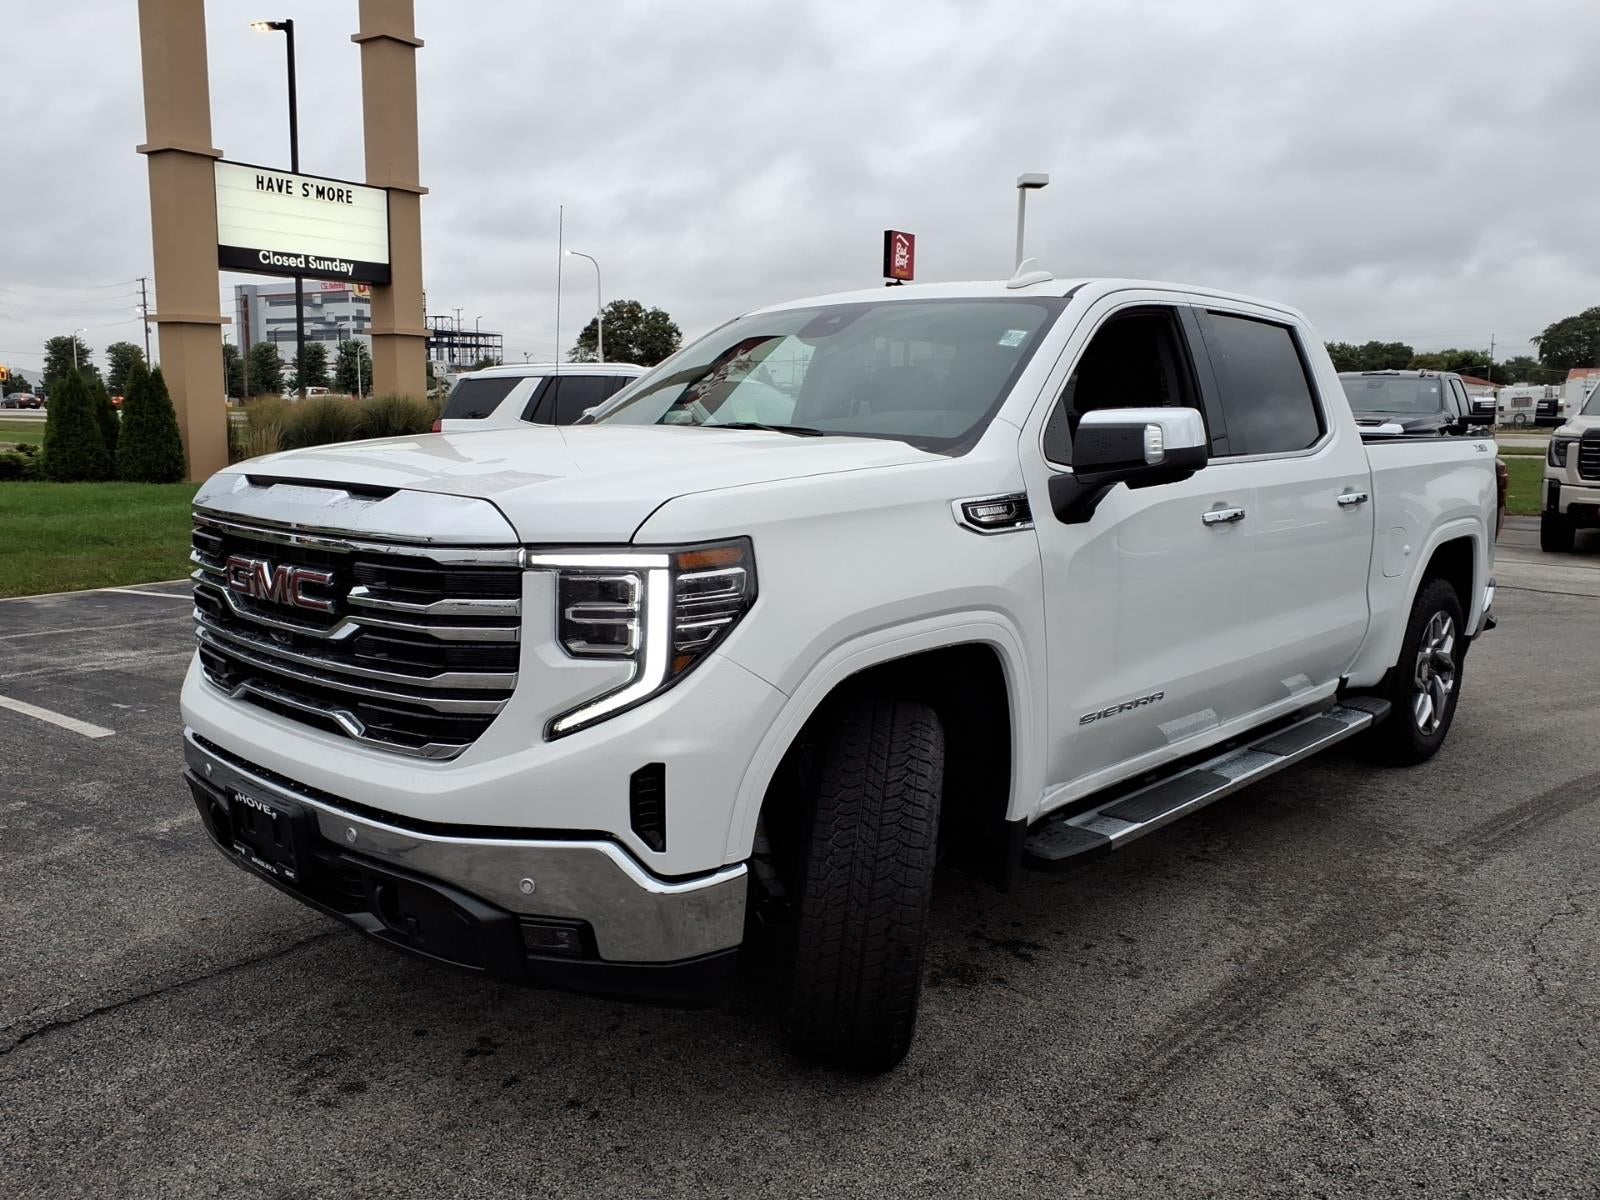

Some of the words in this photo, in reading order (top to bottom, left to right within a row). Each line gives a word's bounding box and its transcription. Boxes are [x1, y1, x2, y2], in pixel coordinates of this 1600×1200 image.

[256, 174, 293, 195] HAVE
[302, 182, 353, 204] S'MORE
[258, 250, 306, 268] Closed
[308, 255, 354, 275] Sunday
[226, 555, 335, 614] GMC
[1078, 691, 1165, 726] SIERRA
[238, 792, 272, 816] HOVE
